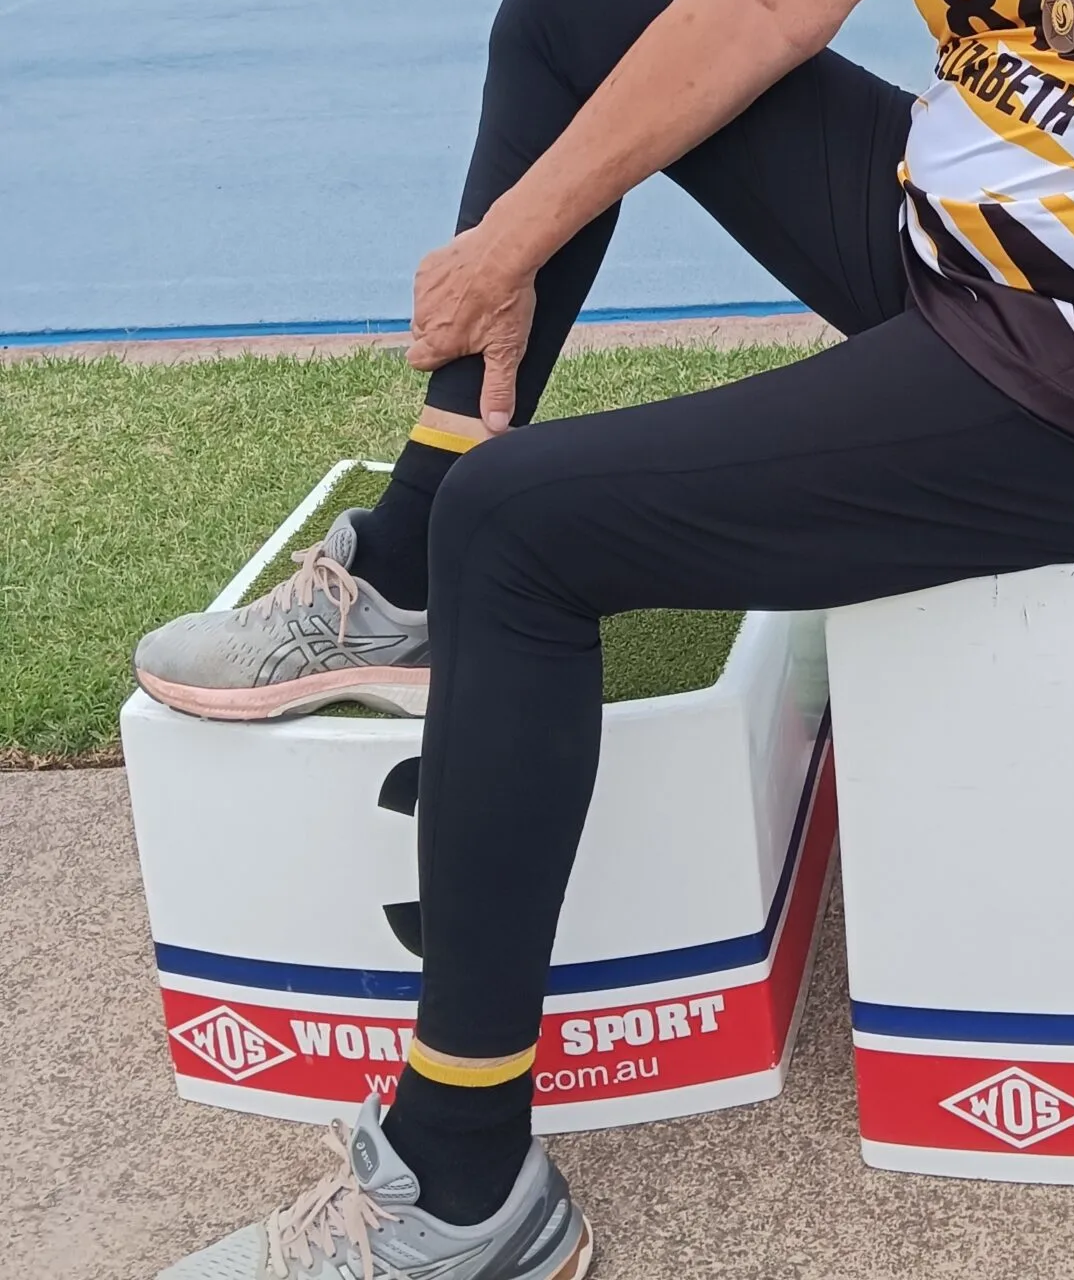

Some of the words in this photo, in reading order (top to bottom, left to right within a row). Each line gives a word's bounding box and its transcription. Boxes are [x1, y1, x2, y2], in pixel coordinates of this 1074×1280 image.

[192, 1016, 266, 1070] WOS
[290, 1019, 414, 1062] WOR
[561, 995, 725, 1055] SPORT
[969, 1078, 1061, 1135] WOS
